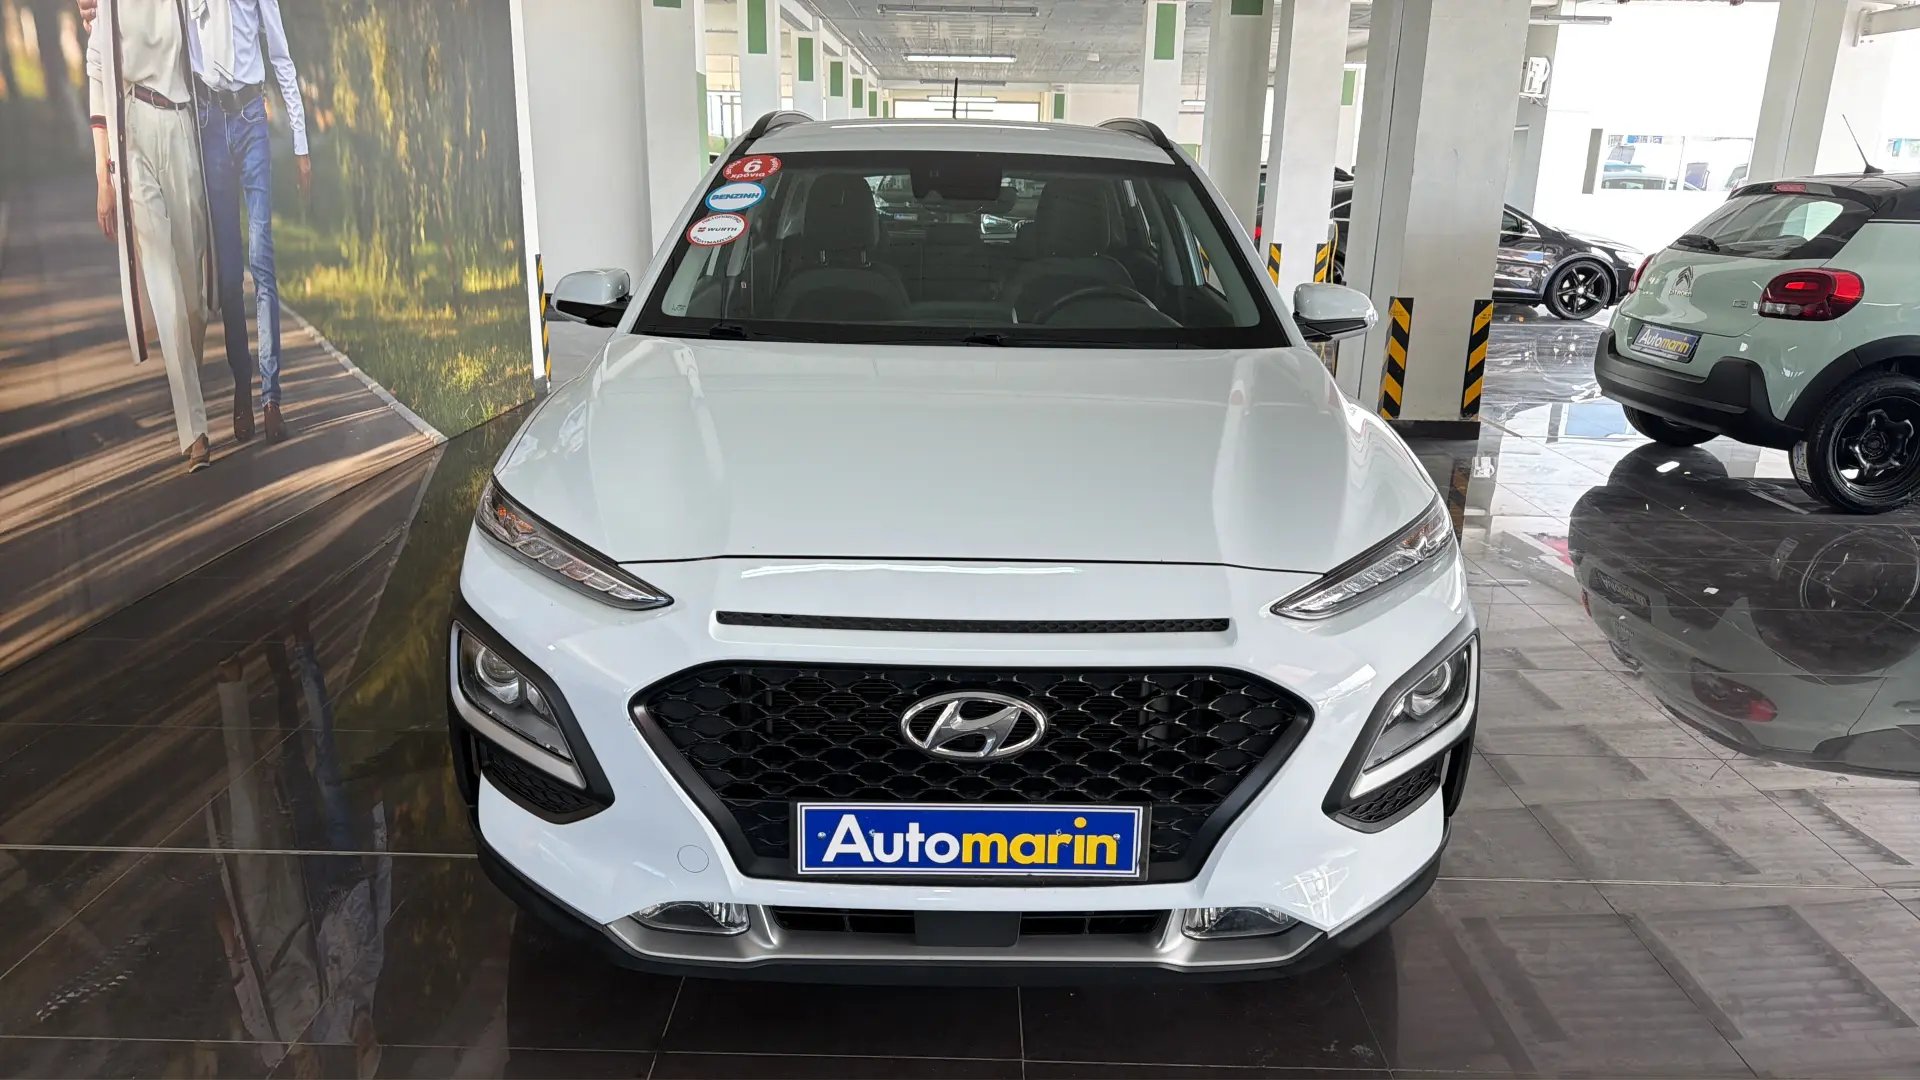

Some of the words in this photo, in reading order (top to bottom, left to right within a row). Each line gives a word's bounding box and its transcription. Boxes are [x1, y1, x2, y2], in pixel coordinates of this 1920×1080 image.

[730, 172, 766, 180] χρόνια
[743, 159, 763, 173] 6
[1638, 328, 1690, 354] Automarin
[821, 813, 1118, 865] Automarin
